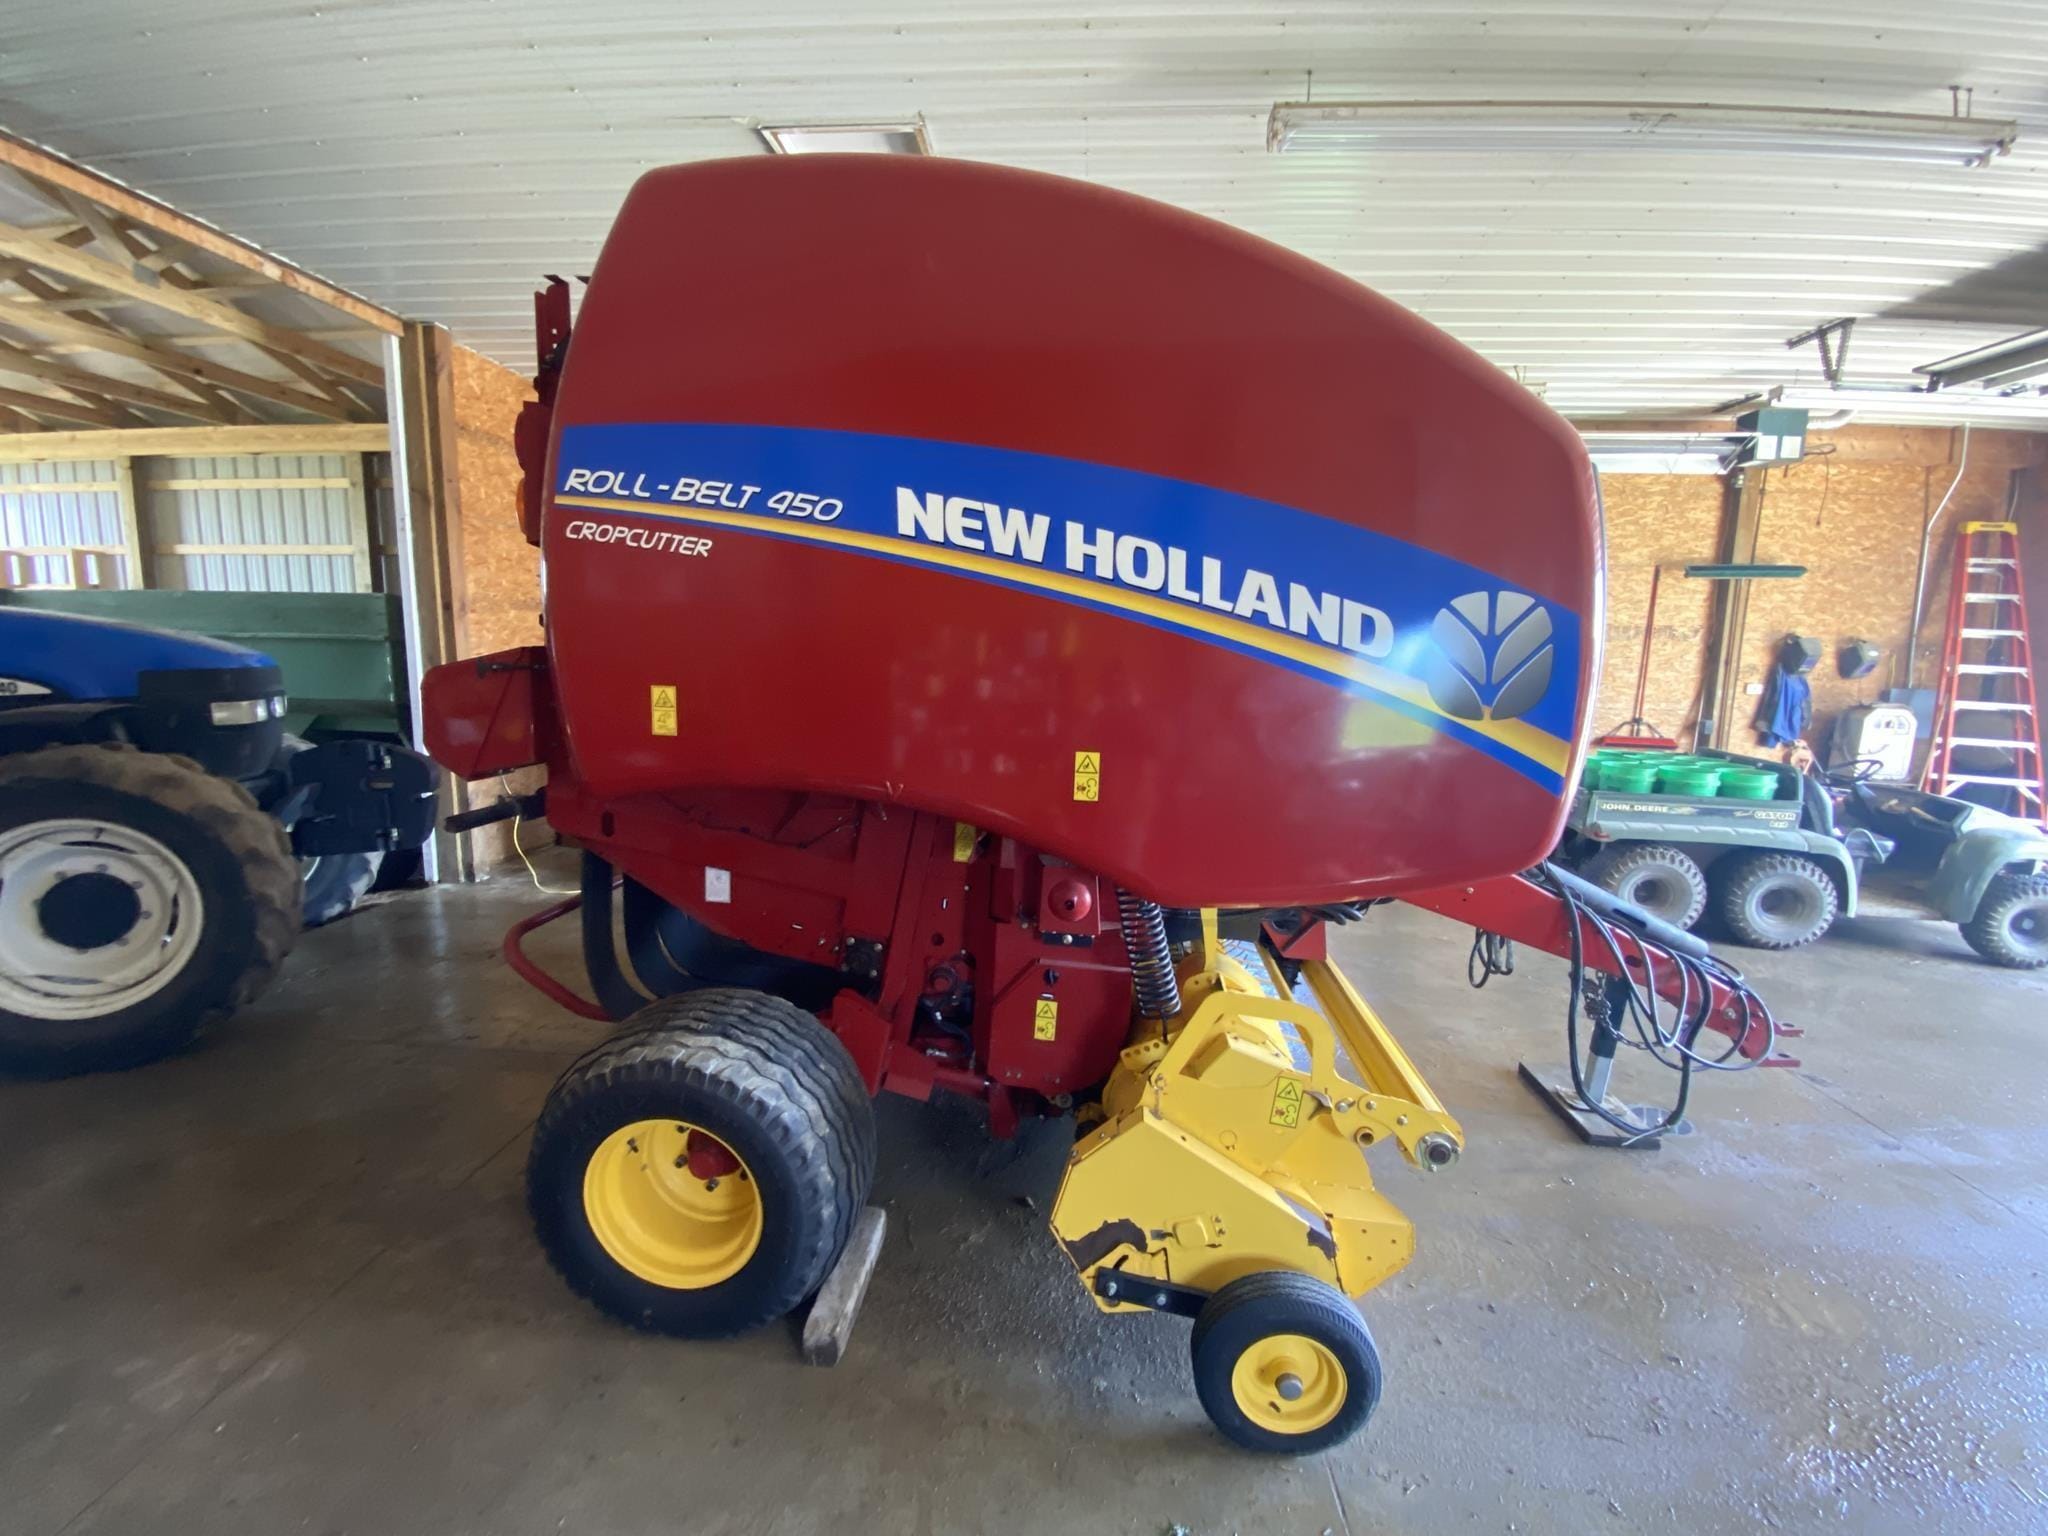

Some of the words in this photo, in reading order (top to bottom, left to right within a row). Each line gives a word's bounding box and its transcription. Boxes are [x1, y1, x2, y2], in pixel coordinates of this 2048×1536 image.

[767, 491, 843, 522] 450
[566, 520, 713, 557] CROPCUTTER
[896, 486, 1050, 564] NEW
[1065, 520, 1395, 659] HOLLAND
[1601, 803, 1630, 811] JOHN
[1634, 804, 1669, 813] DEERE
